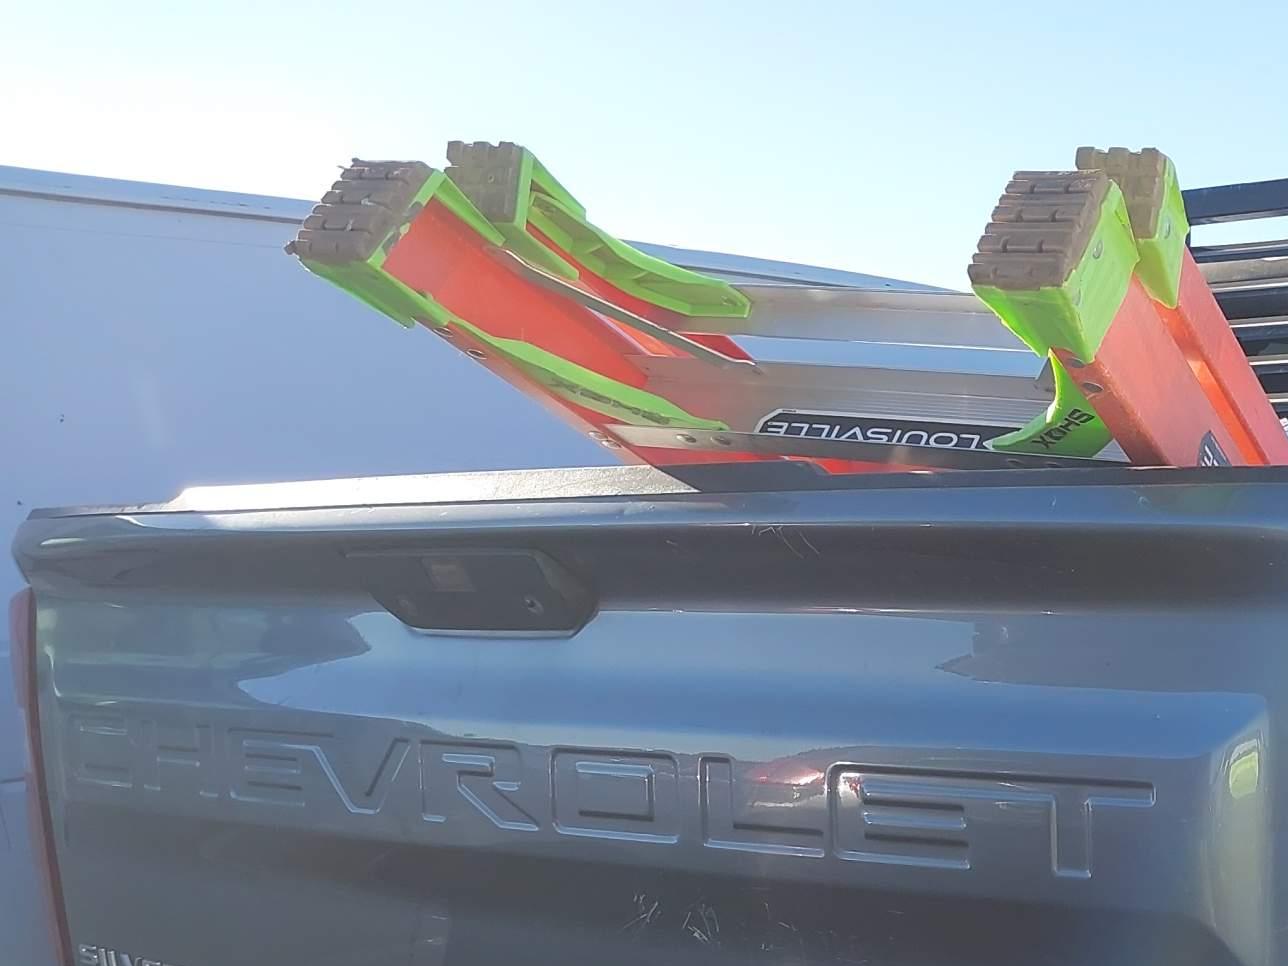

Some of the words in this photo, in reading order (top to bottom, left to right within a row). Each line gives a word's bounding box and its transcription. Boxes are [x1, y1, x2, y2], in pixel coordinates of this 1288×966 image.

[766, 420, 982, 451] LOUISVILLE
[1030, 407, 1095, 450] SHOX
[68, 712, 1158, 880] CHEVROLET
